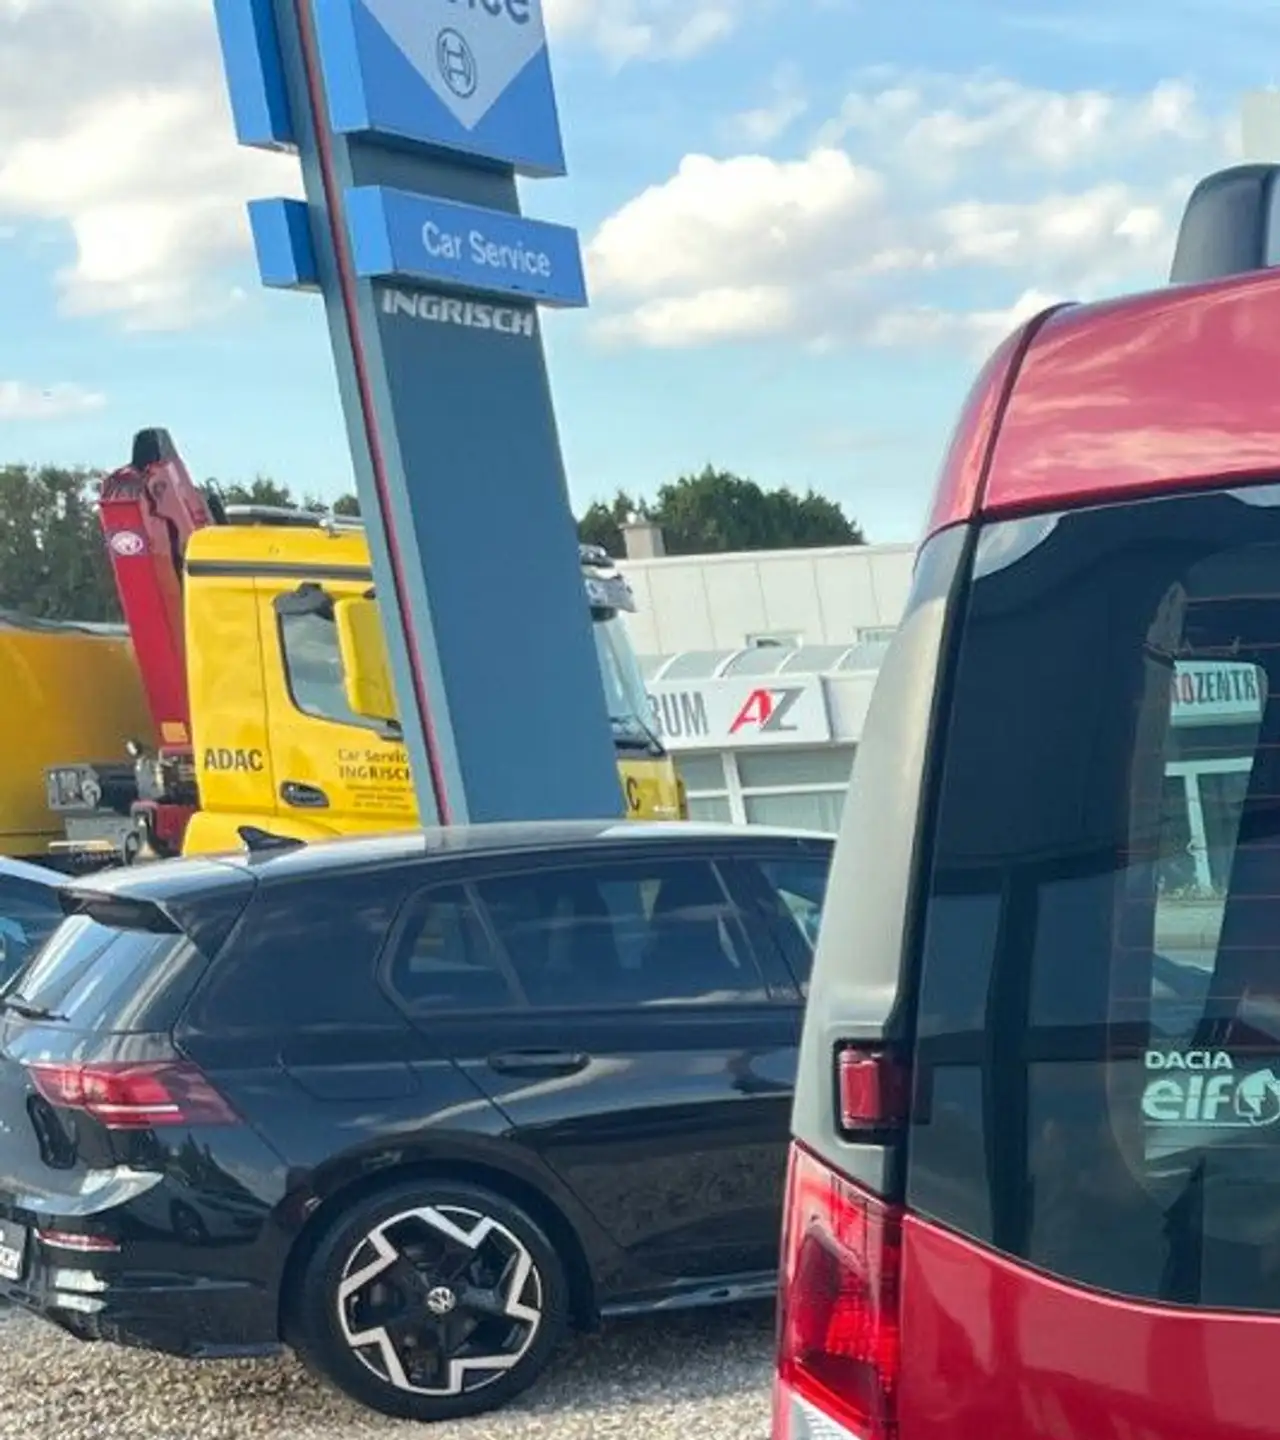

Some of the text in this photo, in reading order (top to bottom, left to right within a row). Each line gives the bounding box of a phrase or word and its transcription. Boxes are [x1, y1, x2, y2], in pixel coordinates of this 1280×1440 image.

[422, 220, 551, 278] Car Service
[382, 288, 534, 337] INGRISCH
[203, 747, 265, 772] ADAC
[365, 749, 411, 765] Servic
[1144, 1050, 1234, 1070] DACIA
[1141, 1074, 1233, 1120] elf
